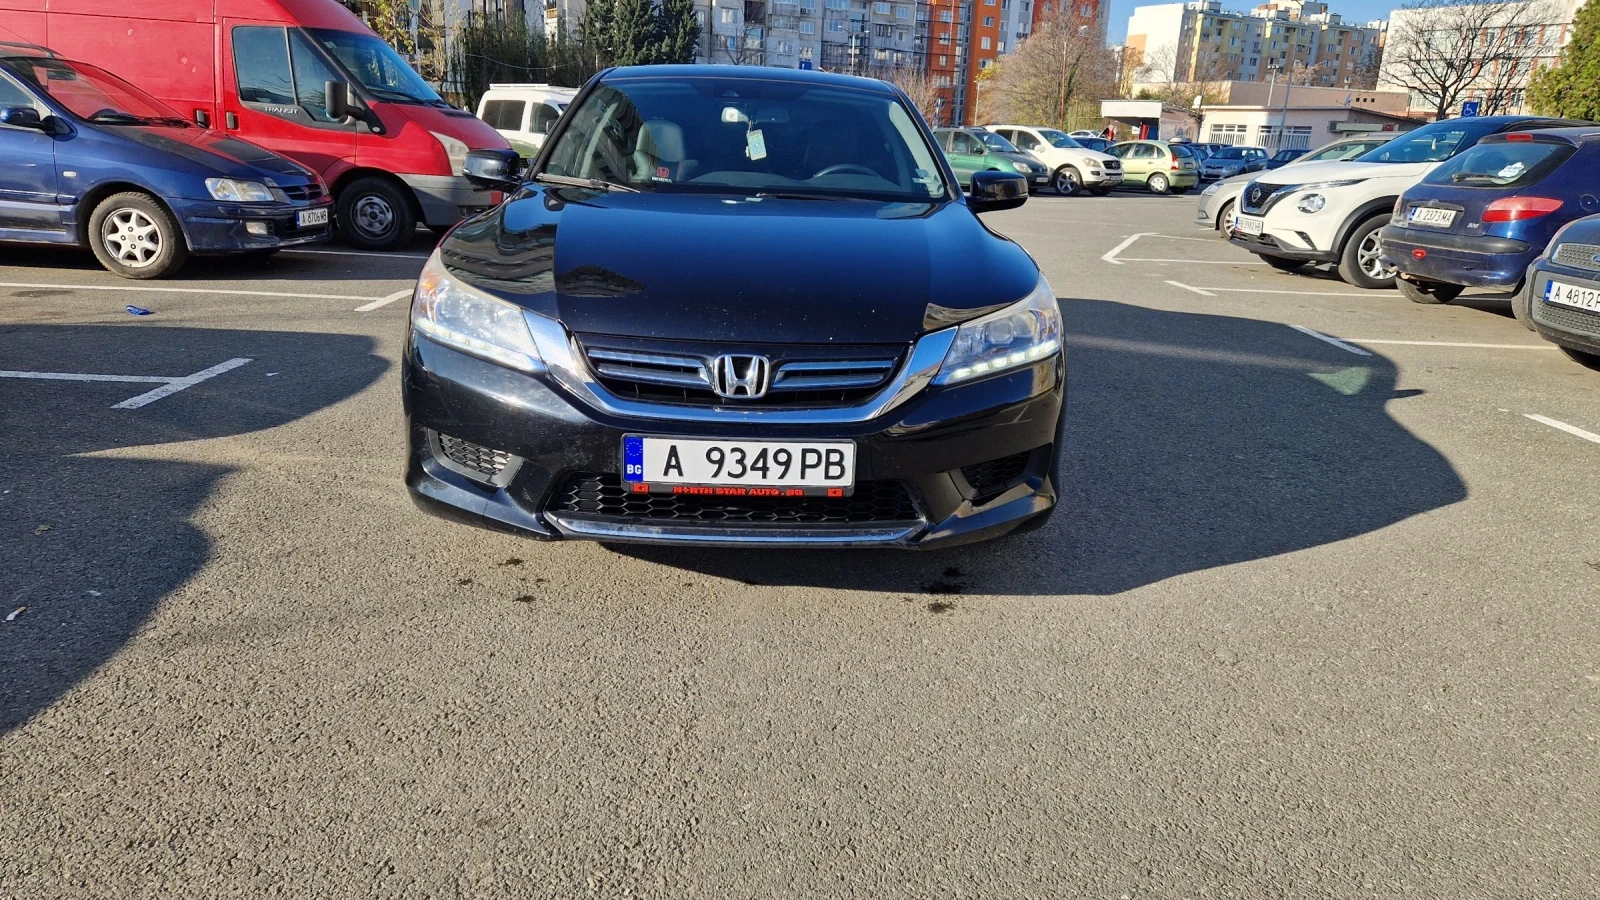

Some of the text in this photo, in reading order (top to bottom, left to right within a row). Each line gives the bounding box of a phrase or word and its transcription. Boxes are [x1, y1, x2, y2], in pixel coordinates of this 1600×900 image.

[265, 106, 299, 115] TRANSIT
[1554, 285, 1561, 301] A
[662, 444, 684, 478] A
[626, 464, 642, 475] BG
[715, 487, 746, 496] STAR
